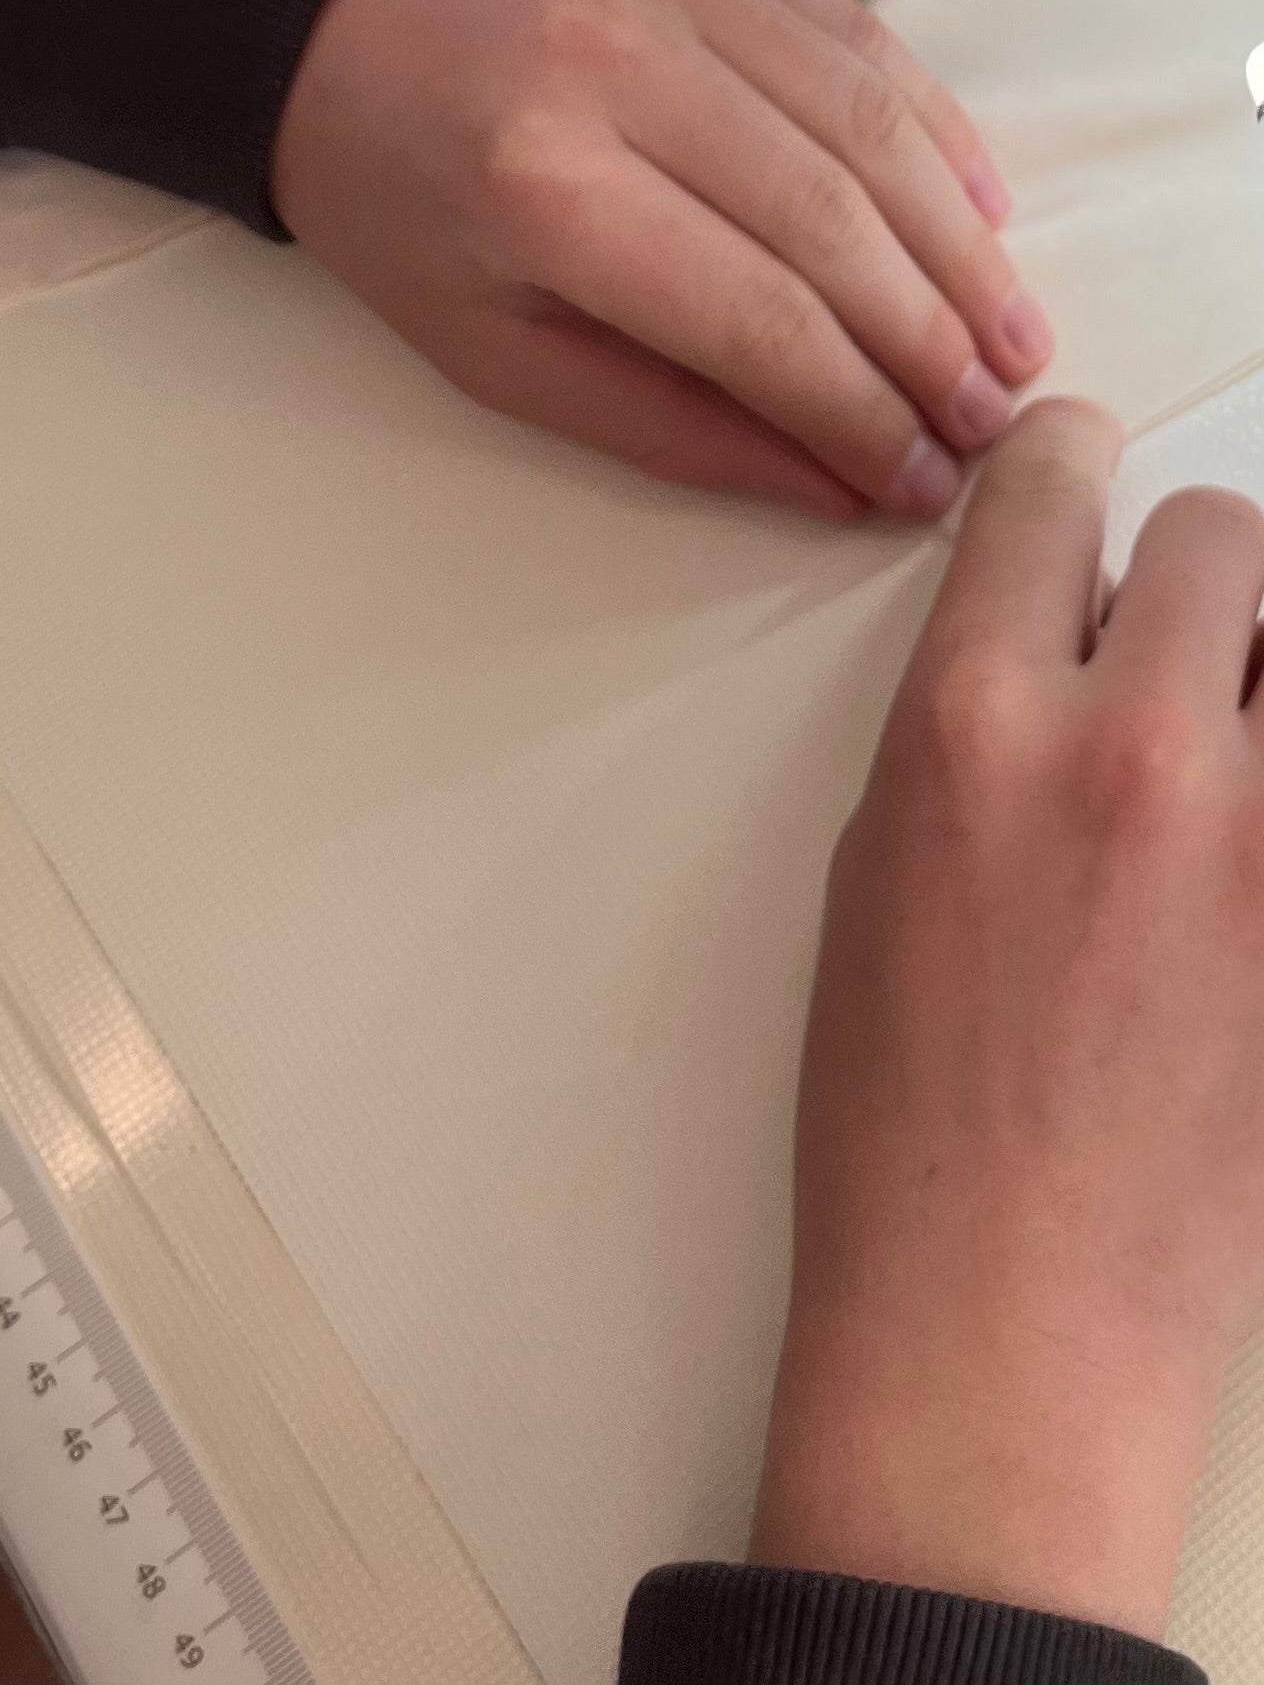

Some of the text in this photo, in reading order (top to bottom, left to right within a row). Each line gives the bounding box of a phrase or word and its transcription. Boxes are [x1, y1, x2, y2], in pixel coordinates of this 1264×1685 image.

[0, 1296, 21, 1331] 44
[27, 1361, 57, 1398] 45
[62, 1427, 93, 1463] 46
[100, 1494, 130, 1526] 47
[137, 1564, 167, 1601] 48
[175, 1633, 205, 1669] 49
